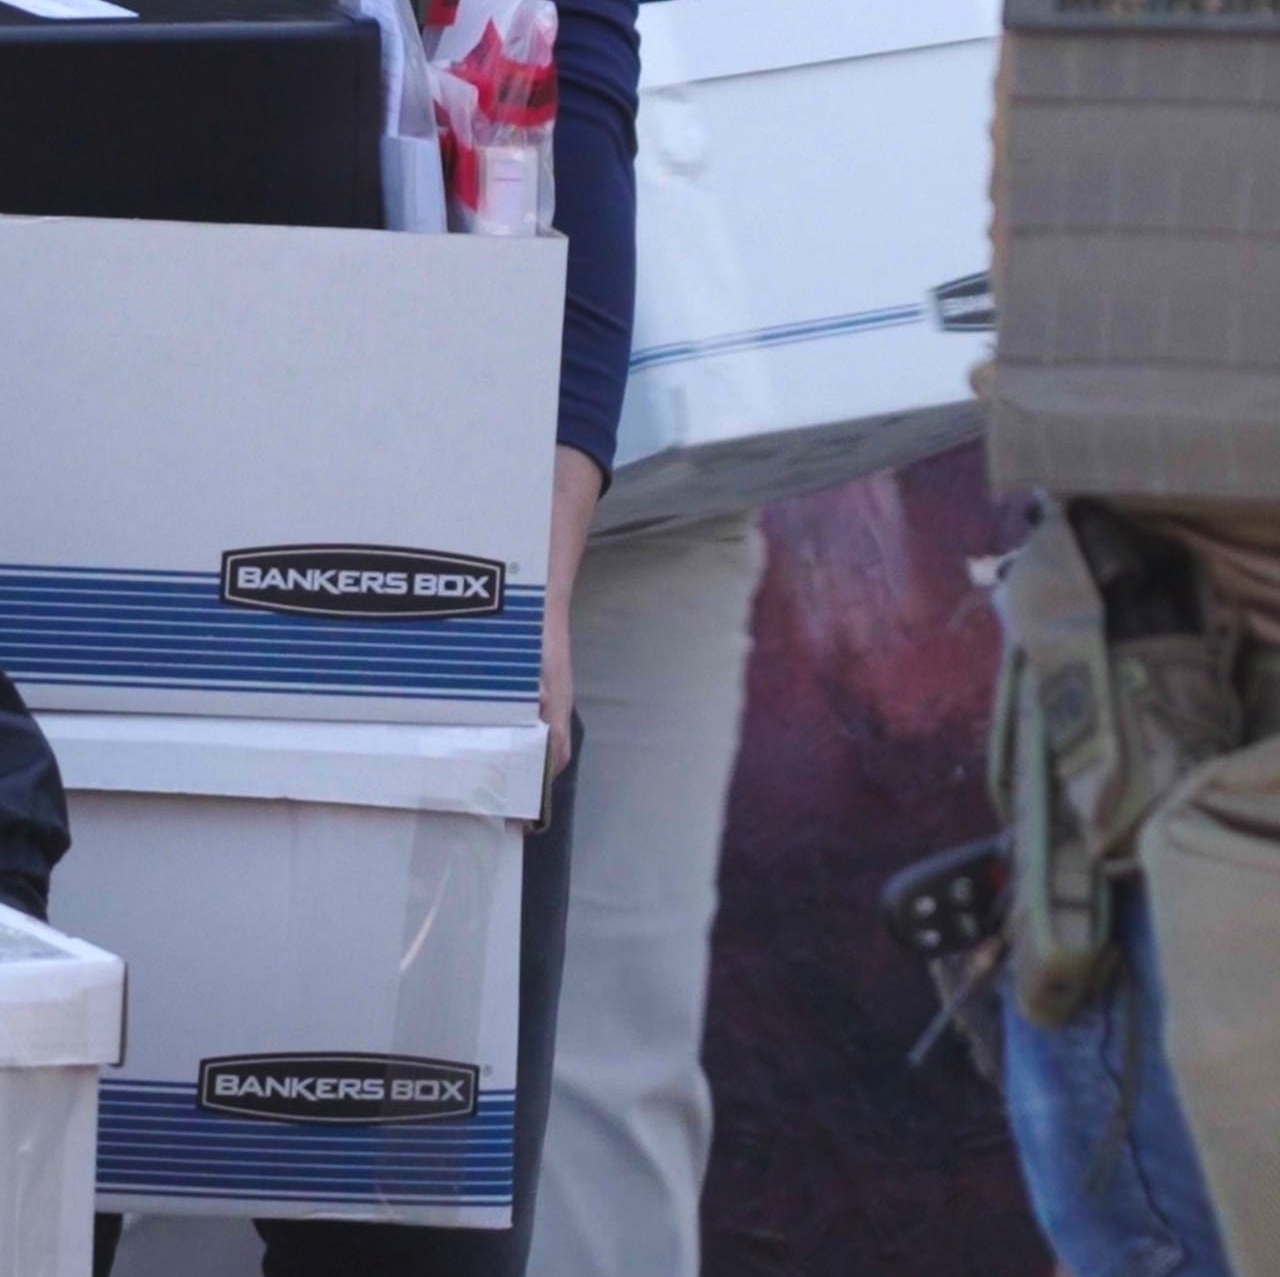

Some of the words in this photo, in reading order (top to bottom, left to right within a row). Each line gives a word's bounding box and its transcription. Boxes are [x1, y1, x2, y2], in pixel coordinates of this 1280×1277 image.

[236, 565, 408, 595] BANKERS
[413, 571, 490, 598] BOX
[214, 1073, 385, 1101] BANKERS
[391, 1078, 465, 1102] BOX
